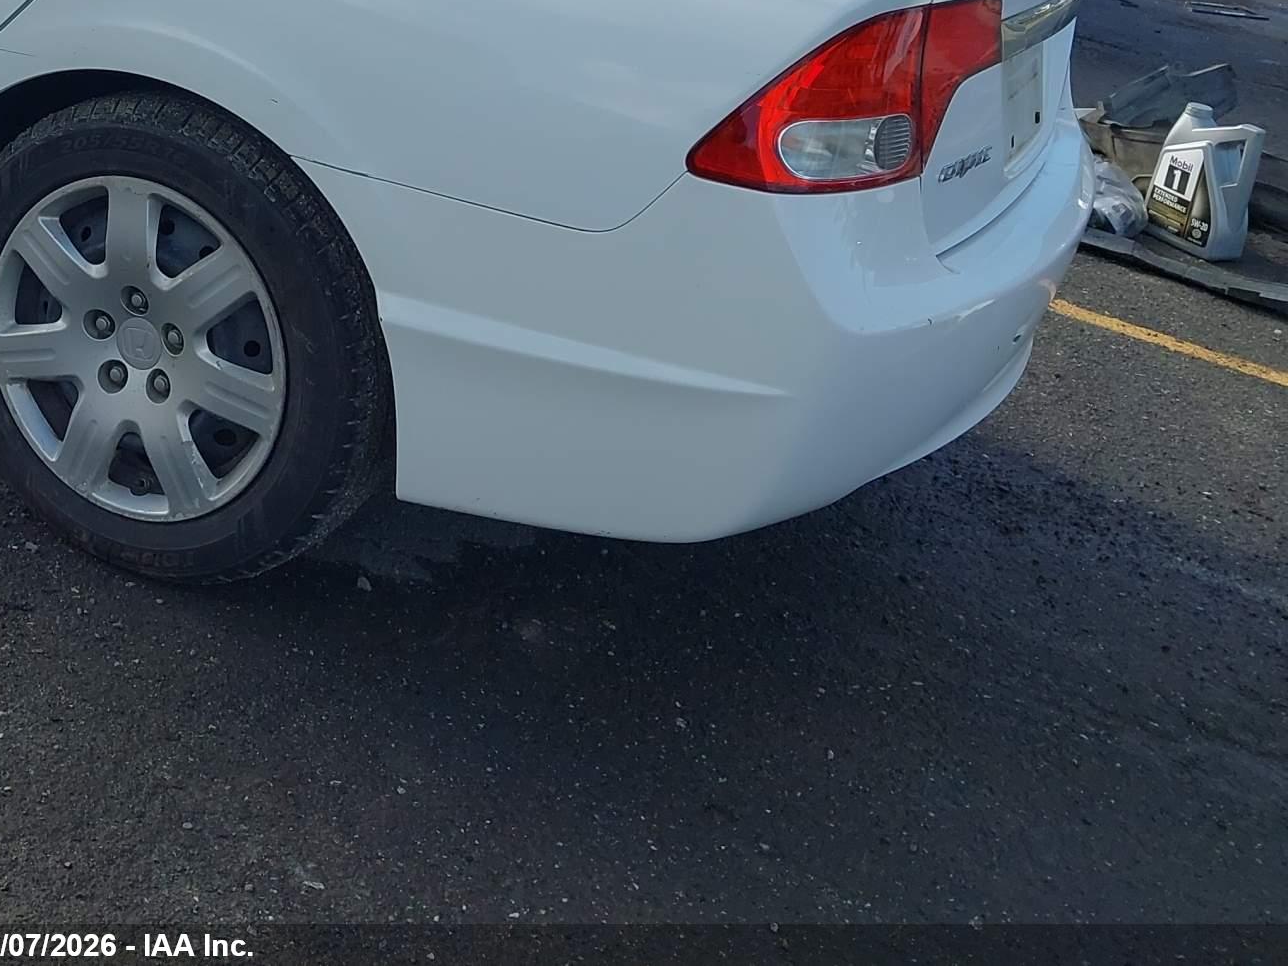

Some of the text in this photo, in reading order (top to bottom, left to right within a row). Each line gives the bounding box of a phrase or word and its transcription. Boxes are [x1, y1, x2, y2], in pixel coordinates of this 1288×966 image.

[1170, 155, 1194, 172] Mobil
[1154, 187, 1178, 202] EXTENDED
[1153, 194, 1187, 214] PERFORMANCE
